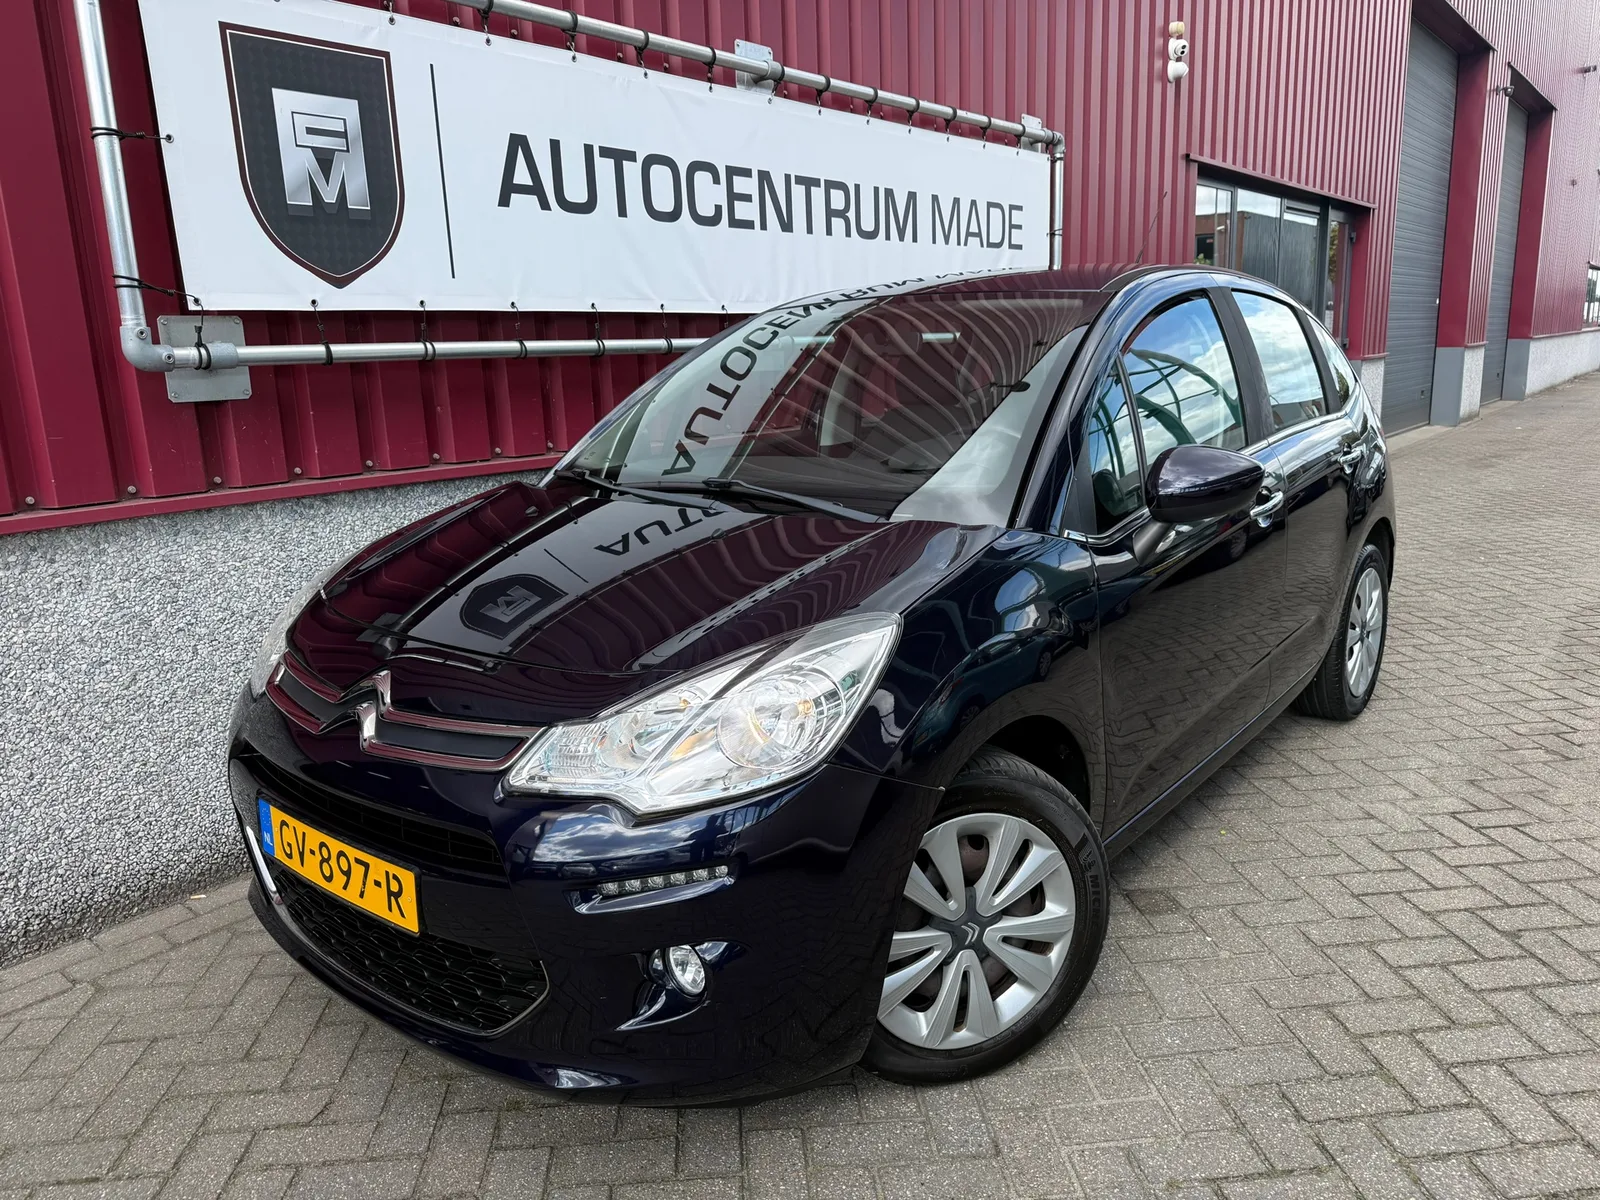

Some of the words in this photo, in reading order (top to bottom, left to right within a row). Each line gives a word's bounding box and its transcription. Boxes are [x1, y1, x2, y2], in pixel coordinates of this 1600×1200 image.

[497, 132, 918, 244] AUTOCENTRUM
[931, 193, 1024, 251] MADE
[263, 831, 274, 846] NL
[279, 819, 407, 919] GV-897-R
